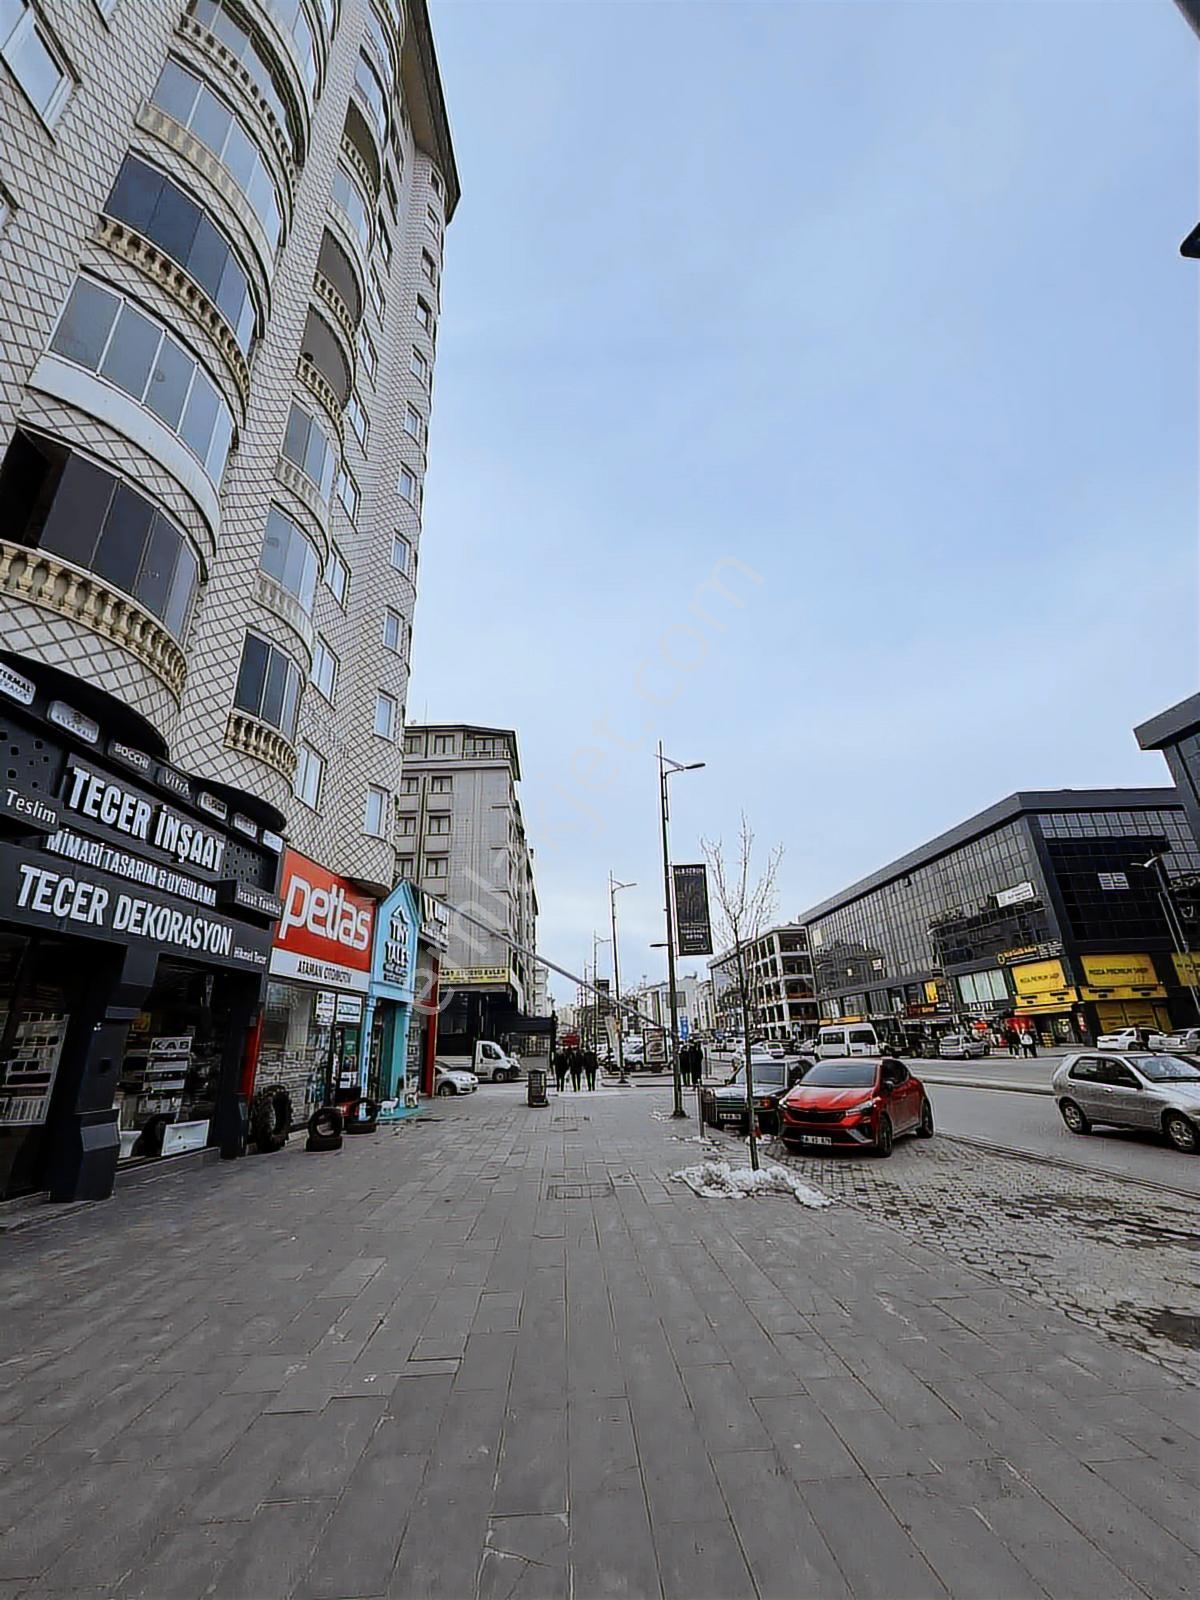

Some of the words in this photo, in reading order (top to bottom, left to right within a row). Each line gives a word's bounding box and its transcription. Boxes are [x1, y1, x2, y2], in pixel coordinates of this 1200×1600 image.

[0, 668, 32, 693] ERMAL
[114, 742, 149, 770] BOCCHI
[165, 770, 190, 795] VitrA
[6, 788, 57, 825] Teslim
[69, 766, 151, 840] TECER
[154, 804, 226, 873] İNŞAAT
[46, 828, 105, 868] MİMARİ
[101, 847, 157, 886] TASARIM
[158, 870, 167, 889] &
[167, 871, 217, 908] UYGULAMA
[17, 863, 109, 927] TECER
[112, 894, 233, 957] DEKORASYON
[278, 873, 371, 951] petlas
